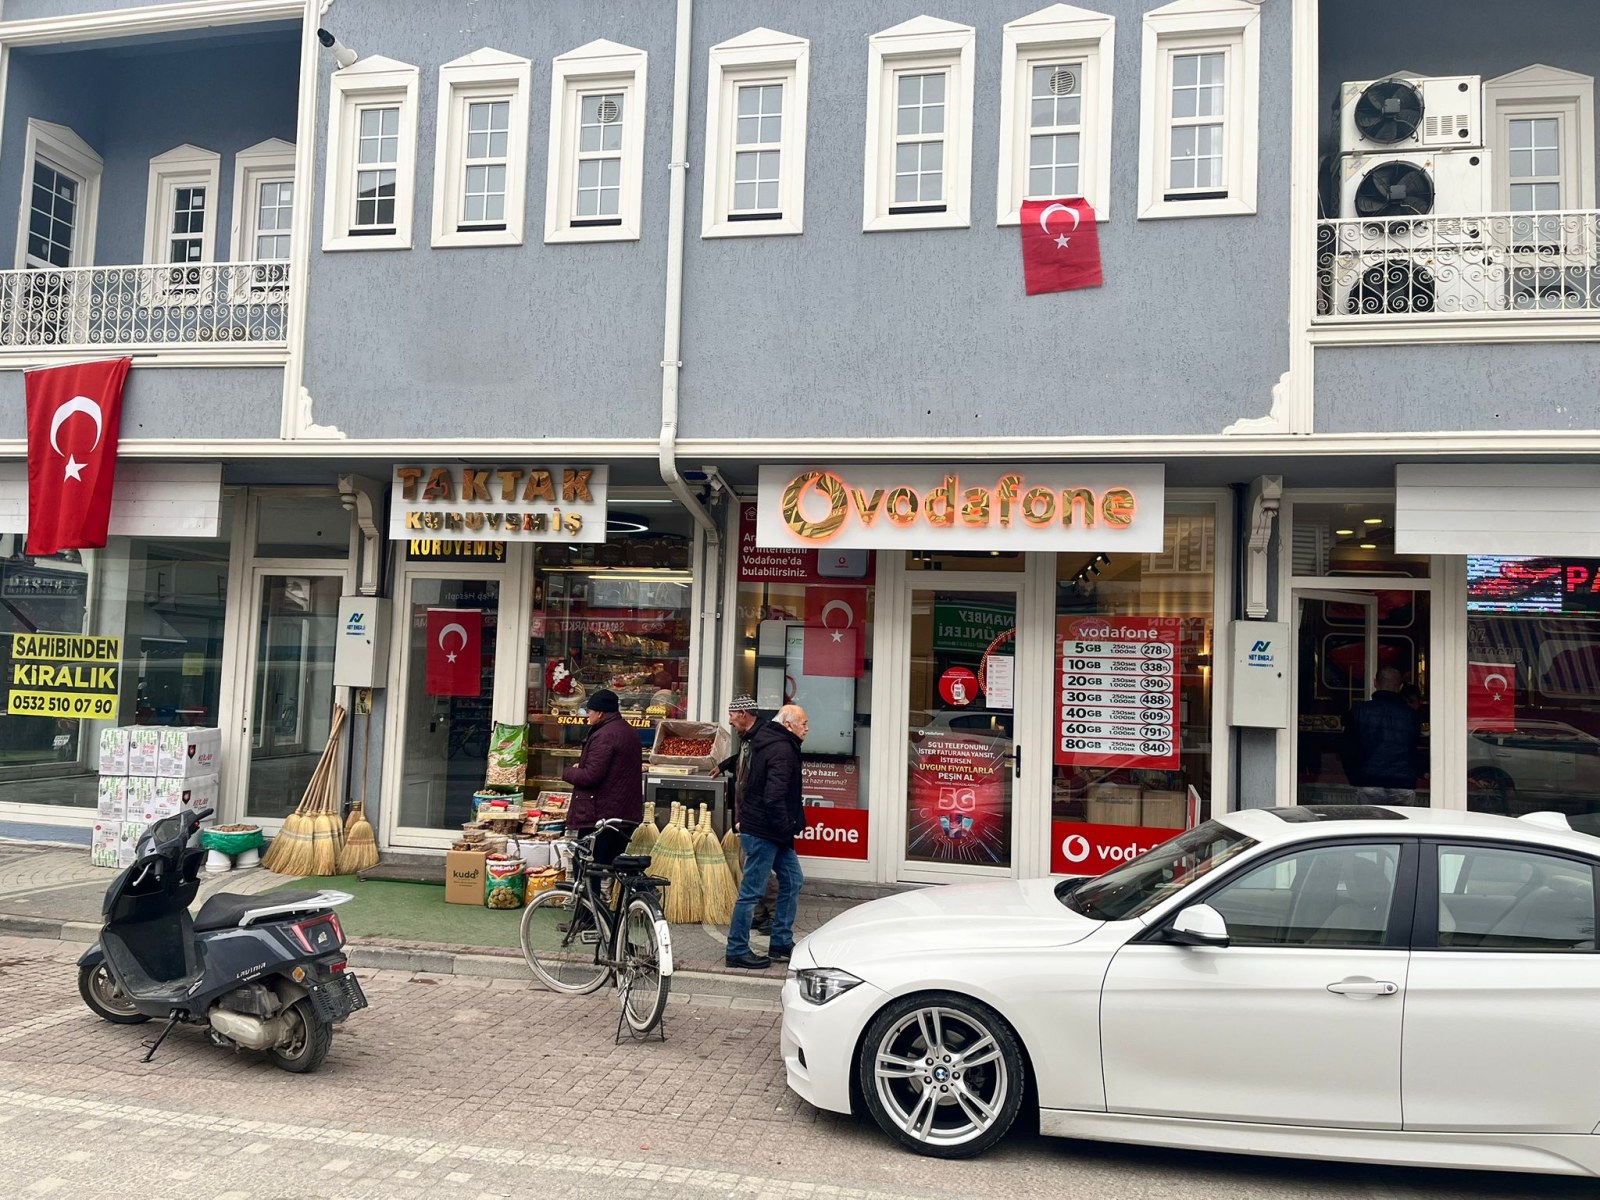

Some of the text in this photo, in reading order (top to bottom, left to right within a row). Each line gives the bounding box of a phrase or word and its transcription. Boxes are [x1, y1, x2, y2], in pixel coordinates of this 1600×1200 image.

[397, 468, 593, 501] TAKTAK
[851, 475, 1135, 527] vodafone
[405, 507, 583, 536] KURUYEMİŞ
[743, 555, 802, 566] Vodafone'da
[742, 567, 807, 577] bulabilirsiniz.
[1079, 626, 1158, 639] vodafone
[13, 695, 112, 714] 0532 510 07 90
[558, 716, 585, 726] SICAK
[945, 743, 989, 751] TELEFONUNU
[937, 749, 970, 757] FATURANA
[919, 763, 947, 771] UYGUN
[818, 769, 839, 777] hazır.
[938, 772, 962, 781] PEŞİN
[938, 787, 976, 812] 5G
[1097, 842, 1159, 862] vod
